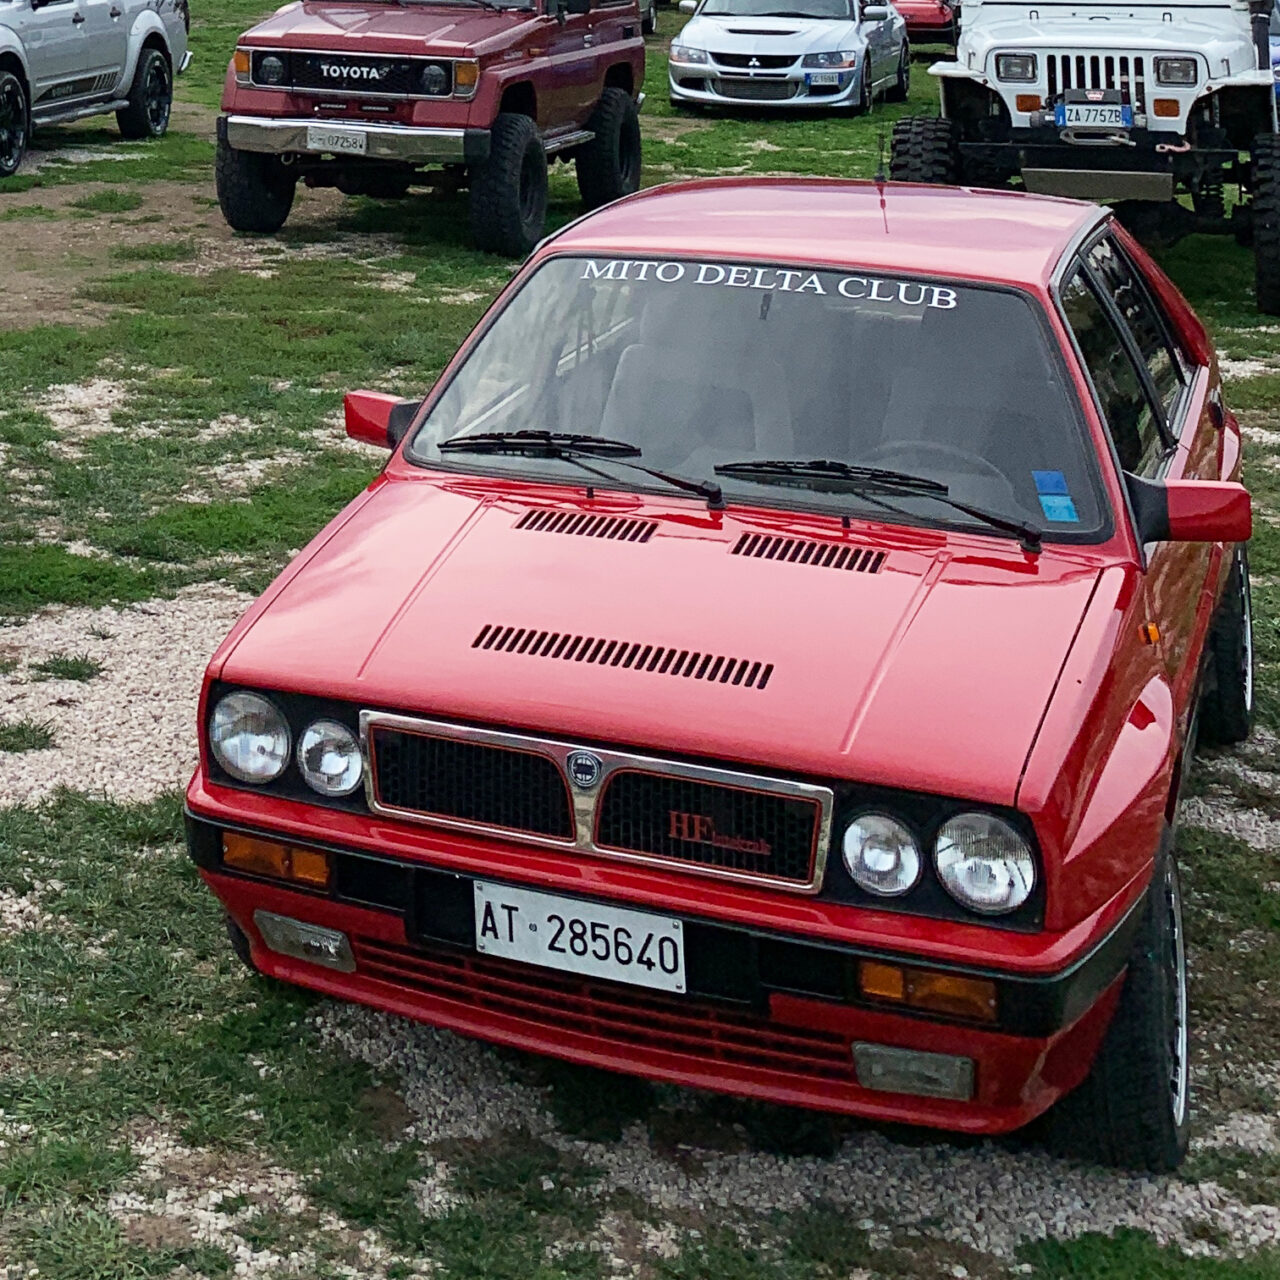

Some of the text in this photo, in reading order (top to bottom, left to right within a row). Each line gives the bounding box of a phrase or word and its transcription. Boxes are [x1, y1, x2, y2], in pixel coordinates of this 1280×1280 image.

[321, 64, 380, 80] TOYOTA
[1066, 108, 1081, 122] ZA
[580, 260, 959, 310] MITO DELTA CLUB
[480, 900, 680, 975] AT 285640
